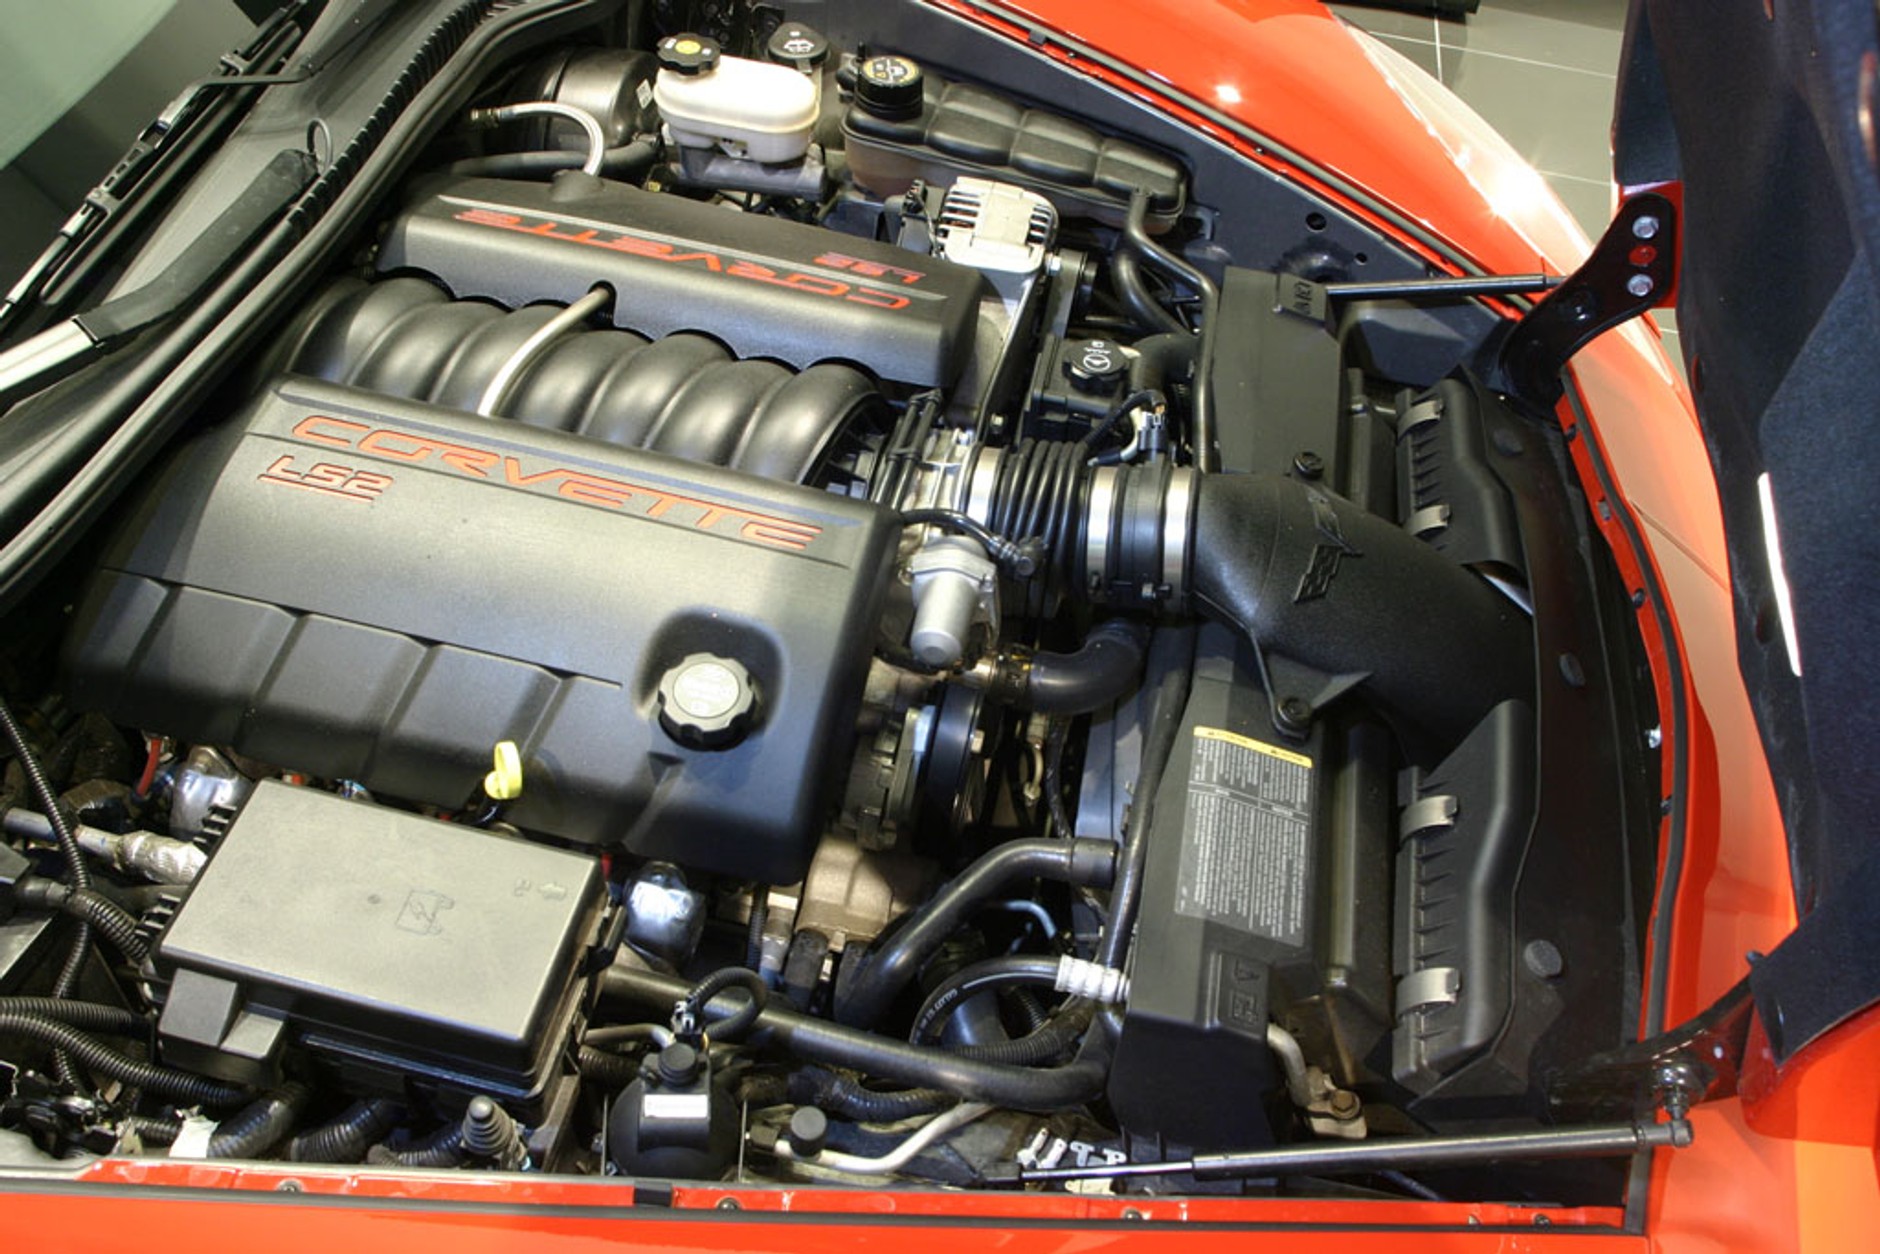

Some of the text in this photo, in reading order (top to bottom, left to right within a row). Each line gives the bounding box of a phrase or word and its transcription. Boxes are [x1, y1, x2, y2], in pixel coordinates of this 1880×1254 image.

[453, 208, 911, 309] CORVETTE
[257, 454, 395, 503] LS2
[291, 414, 824, 551] CORVETTE
